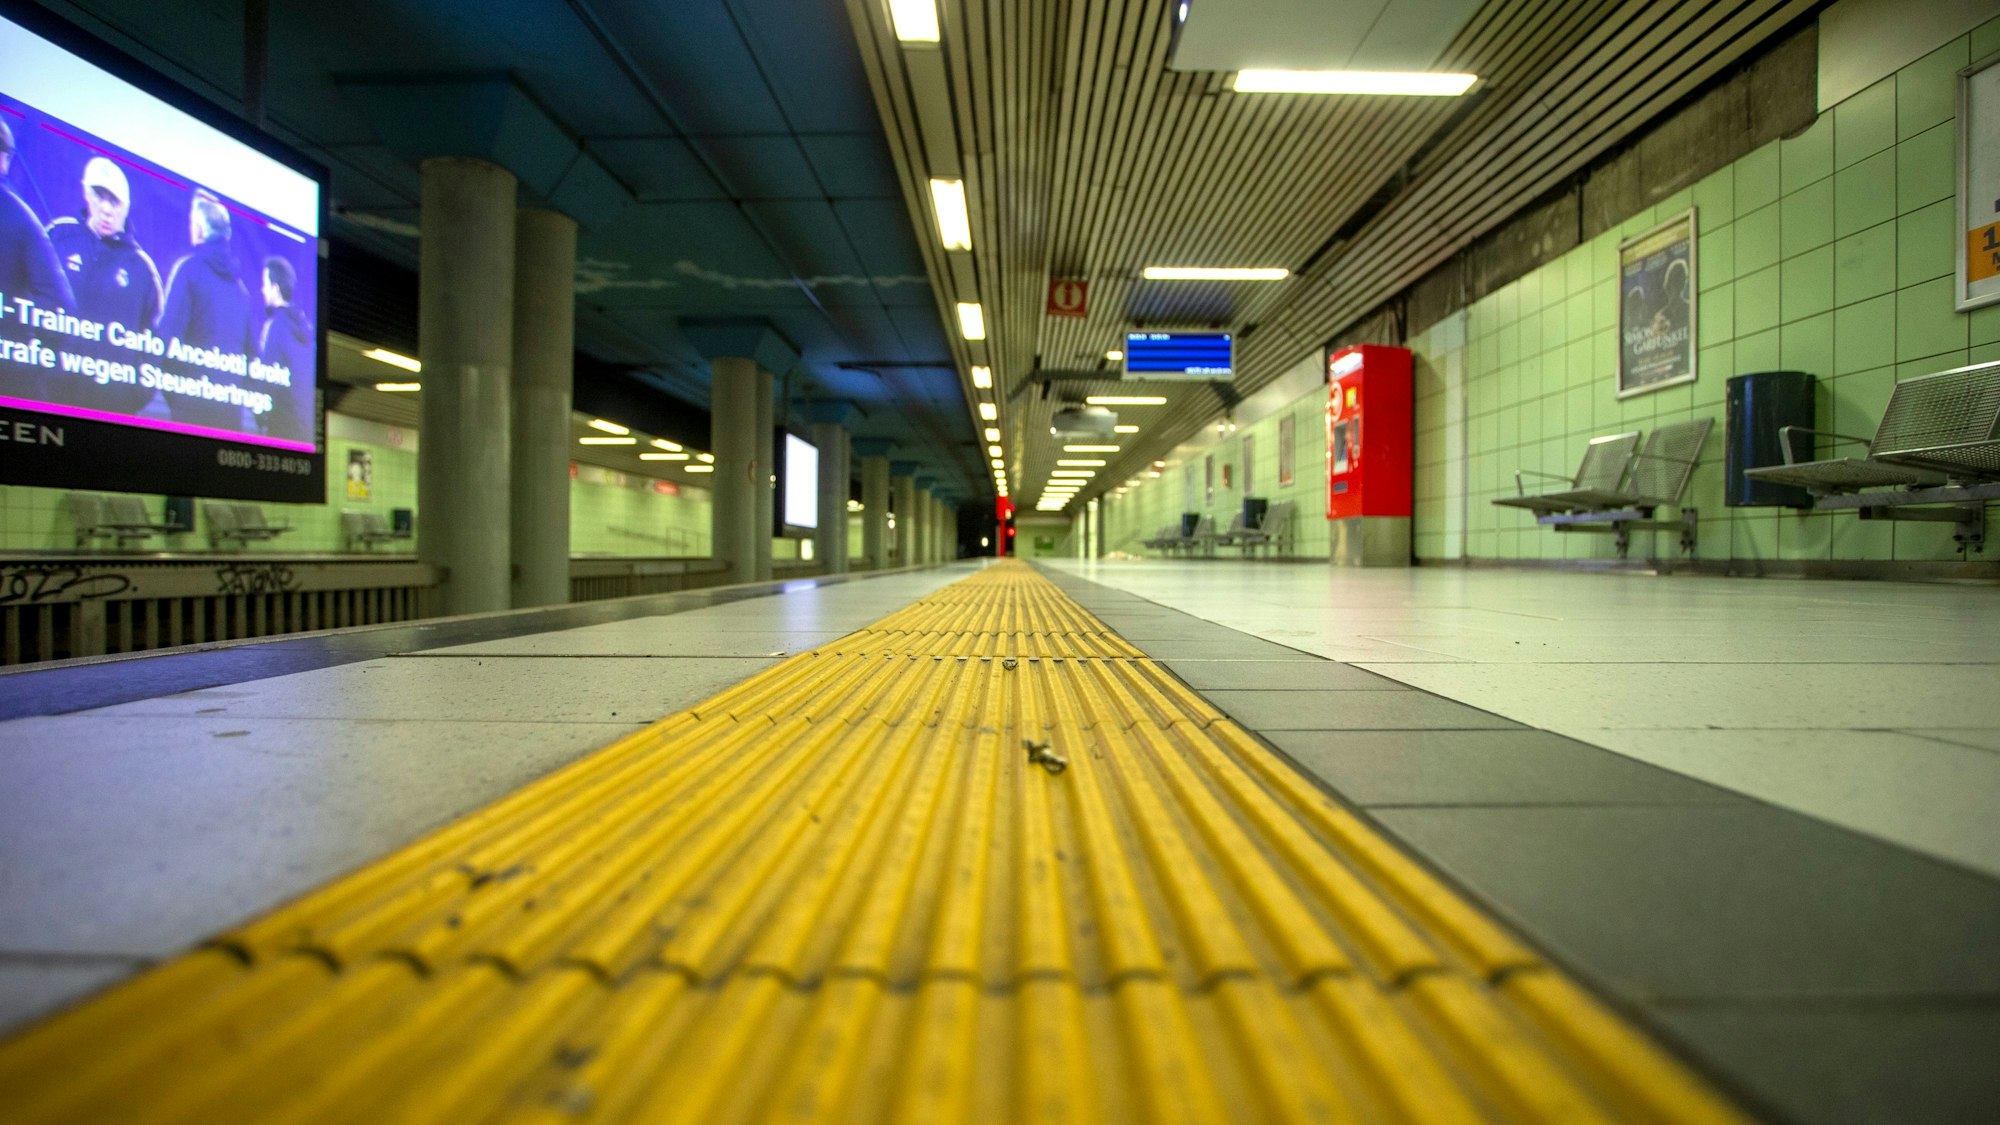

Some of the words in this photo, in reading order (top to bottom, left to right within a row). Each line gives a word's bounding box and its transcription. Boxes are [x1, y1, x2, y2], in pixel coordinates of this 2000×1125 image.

[60, 351, 136, 385] wegen
[108, 322, 165, 356] Carlo
[167, 337, 248, 377] Ancelotti
